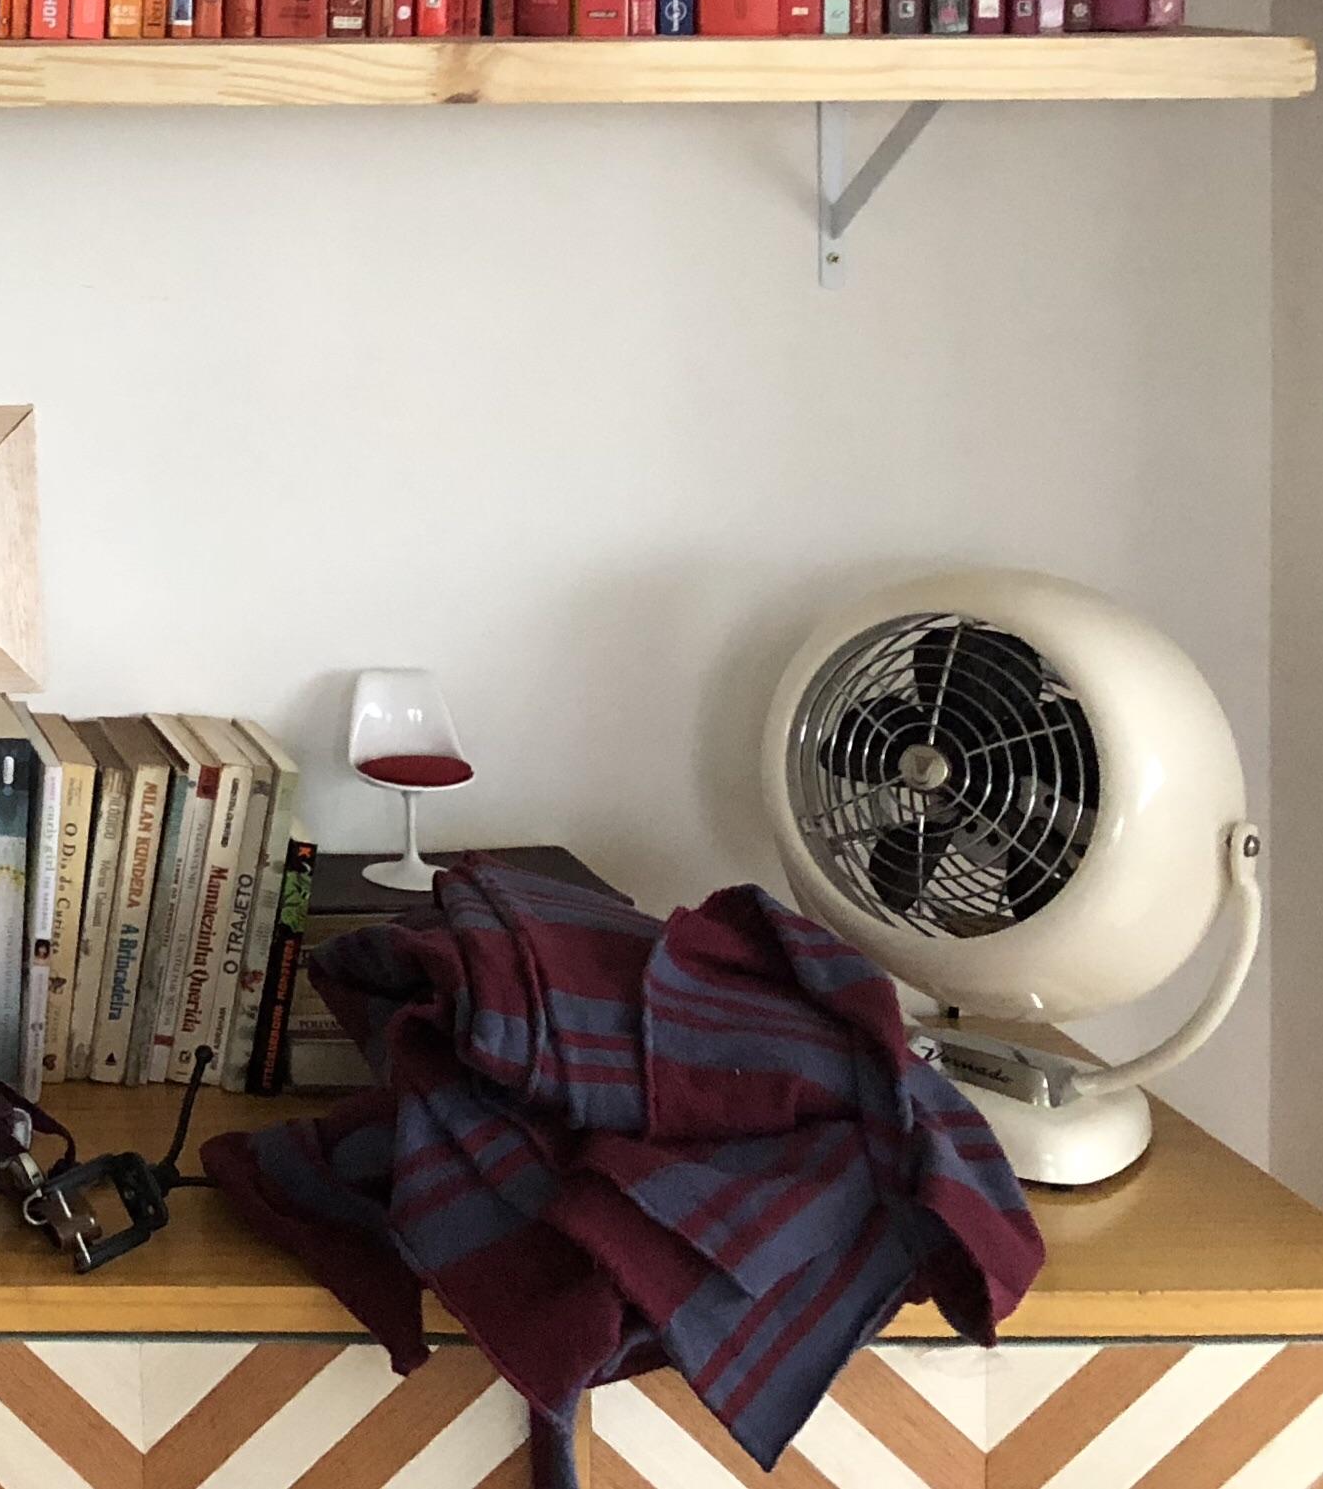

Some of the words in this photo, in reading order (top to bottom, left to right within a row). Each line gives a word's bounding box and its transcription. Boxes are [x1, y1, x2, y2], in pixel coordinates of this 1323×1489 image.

[42, 805, 57, 841] curly
[134, 781, 159, 832] MILAN
[63, 822, 79, 837] O
[41, 846, 55, 872] girl
[125, 835, 154, 909] KUNDERA
[120, 923, 138, 935] A
[225, 873, 253, 954] TRAJETO
[107, 936, 139, 1021] Brincadeira
[221, 958, 239, 974] O
[180, 967, 211, 1033] Querida
